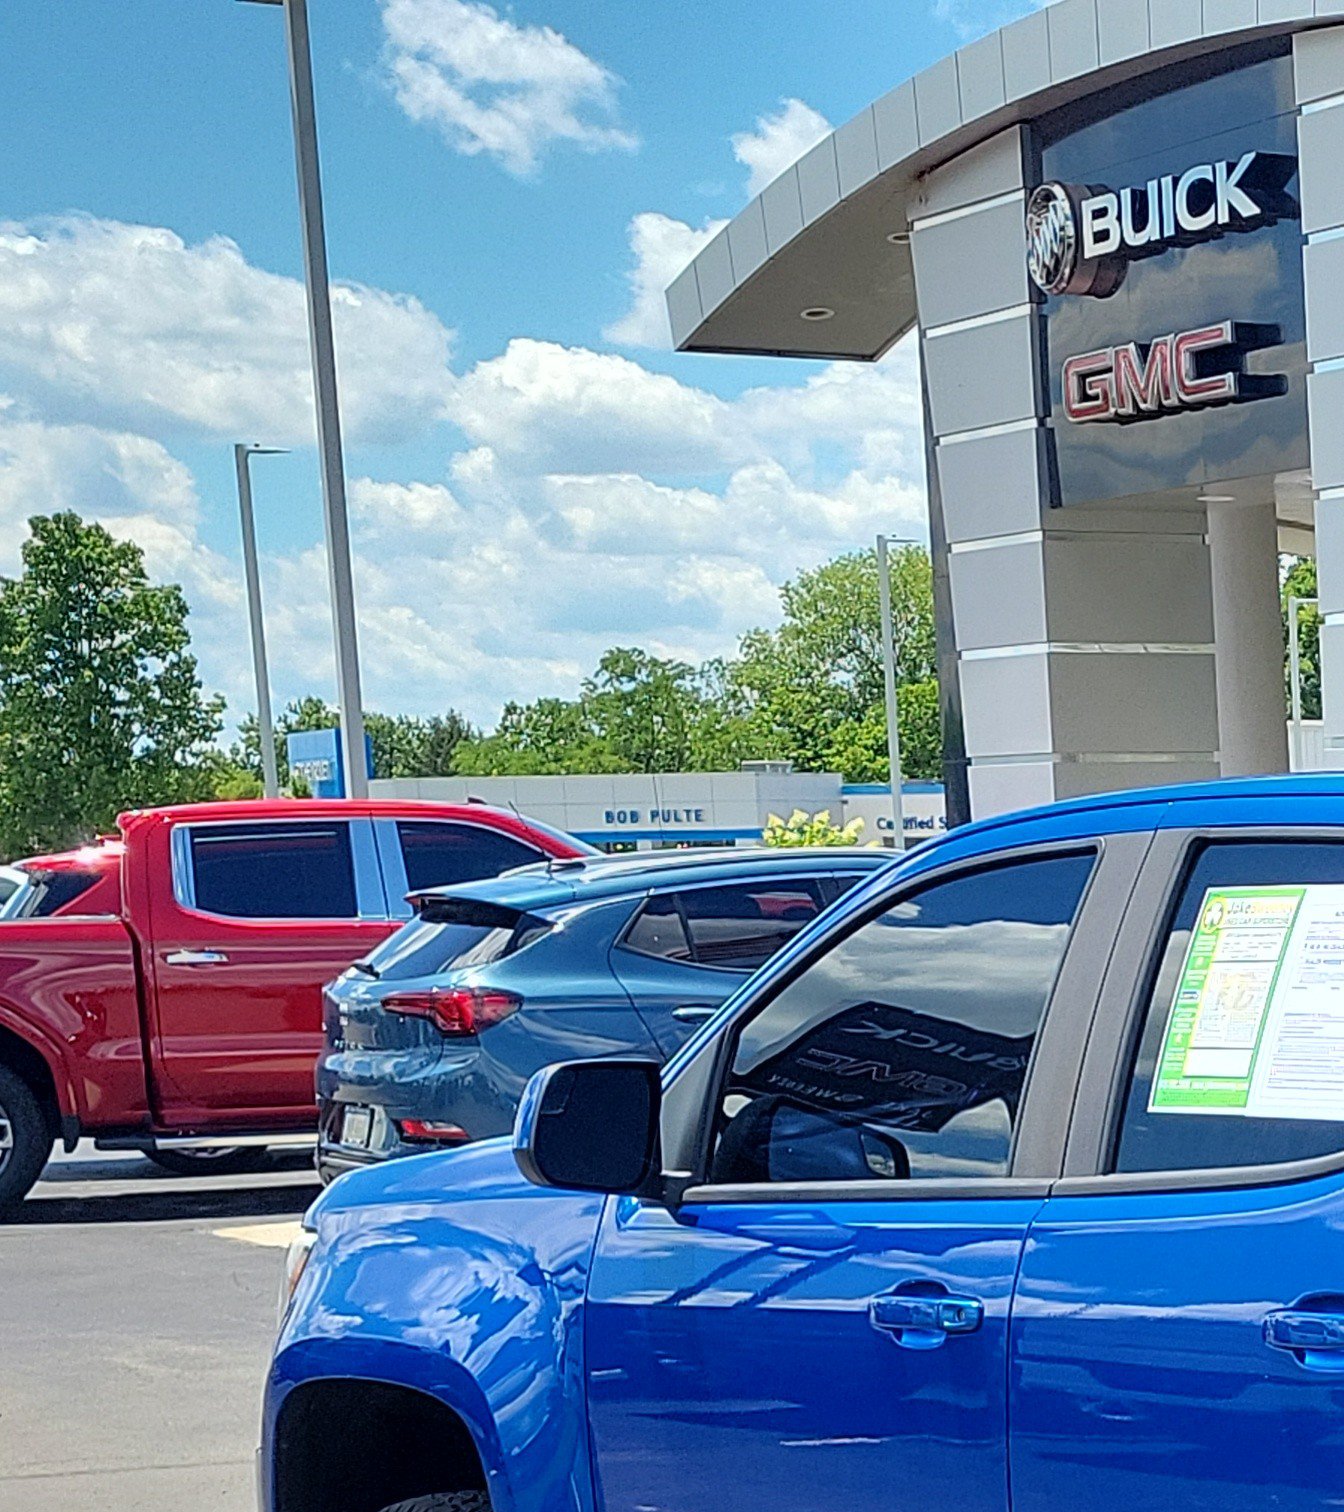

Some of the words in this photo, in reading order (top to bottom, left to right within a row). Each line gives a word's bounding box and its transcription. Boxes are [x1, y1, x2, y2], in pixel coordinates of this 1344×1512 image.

[1080, 151, 1262, 260] BUICK
[1062, 319, 1238, 422] GMC
[604, 810, 640, 824] BOB
[649, 808, 705, 823] PULTE
